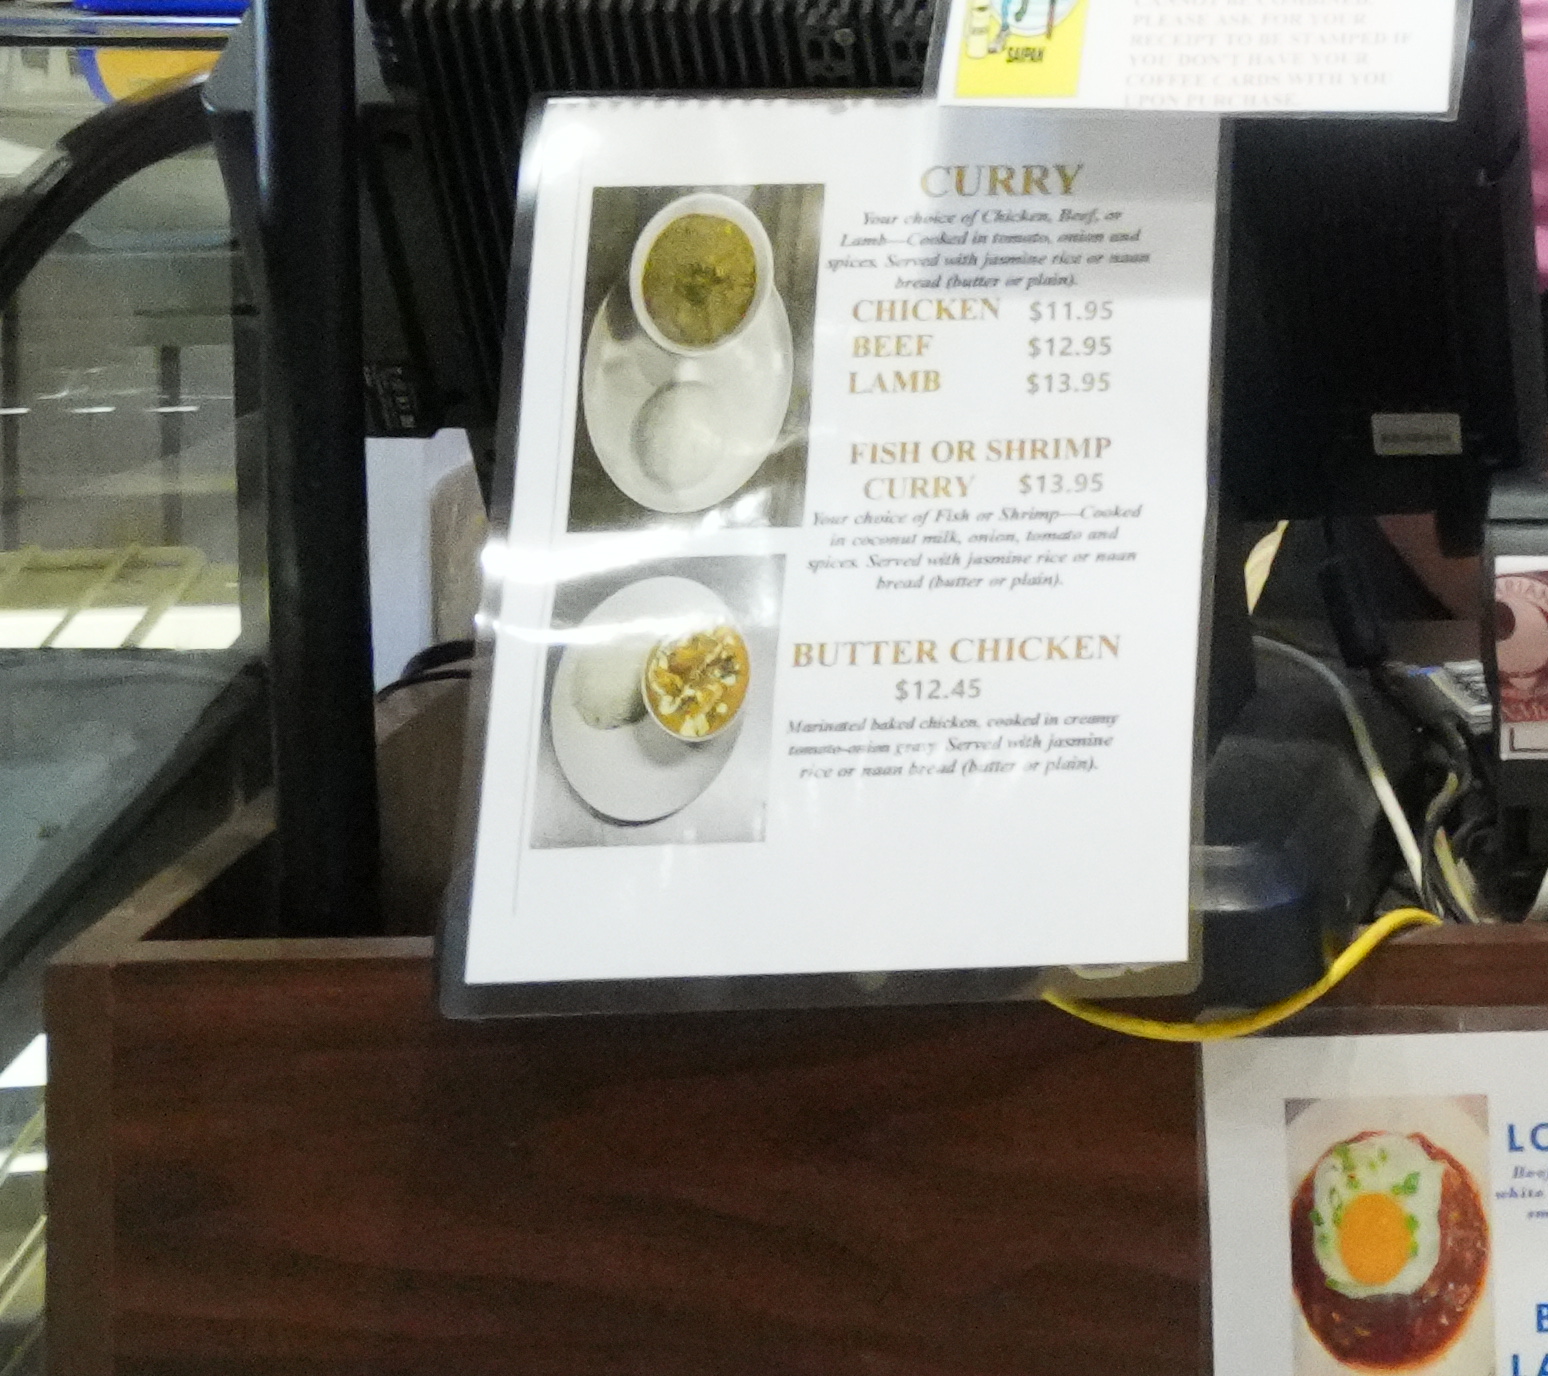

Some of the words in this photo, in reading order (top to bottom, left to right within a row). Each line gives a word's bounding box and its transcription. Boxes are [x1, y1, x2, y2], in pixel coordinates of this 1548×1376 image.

[920, 164, 1083, 198] CURRY
[853, 298, 998, 321] CHICKEN
[1030, 300, 1112, 322] $11.95
[793, 640, 937, 667] BUTTER
[950, 635, 1118, 663] CHICKEN
[896, 678, 981, 702] $12.45
